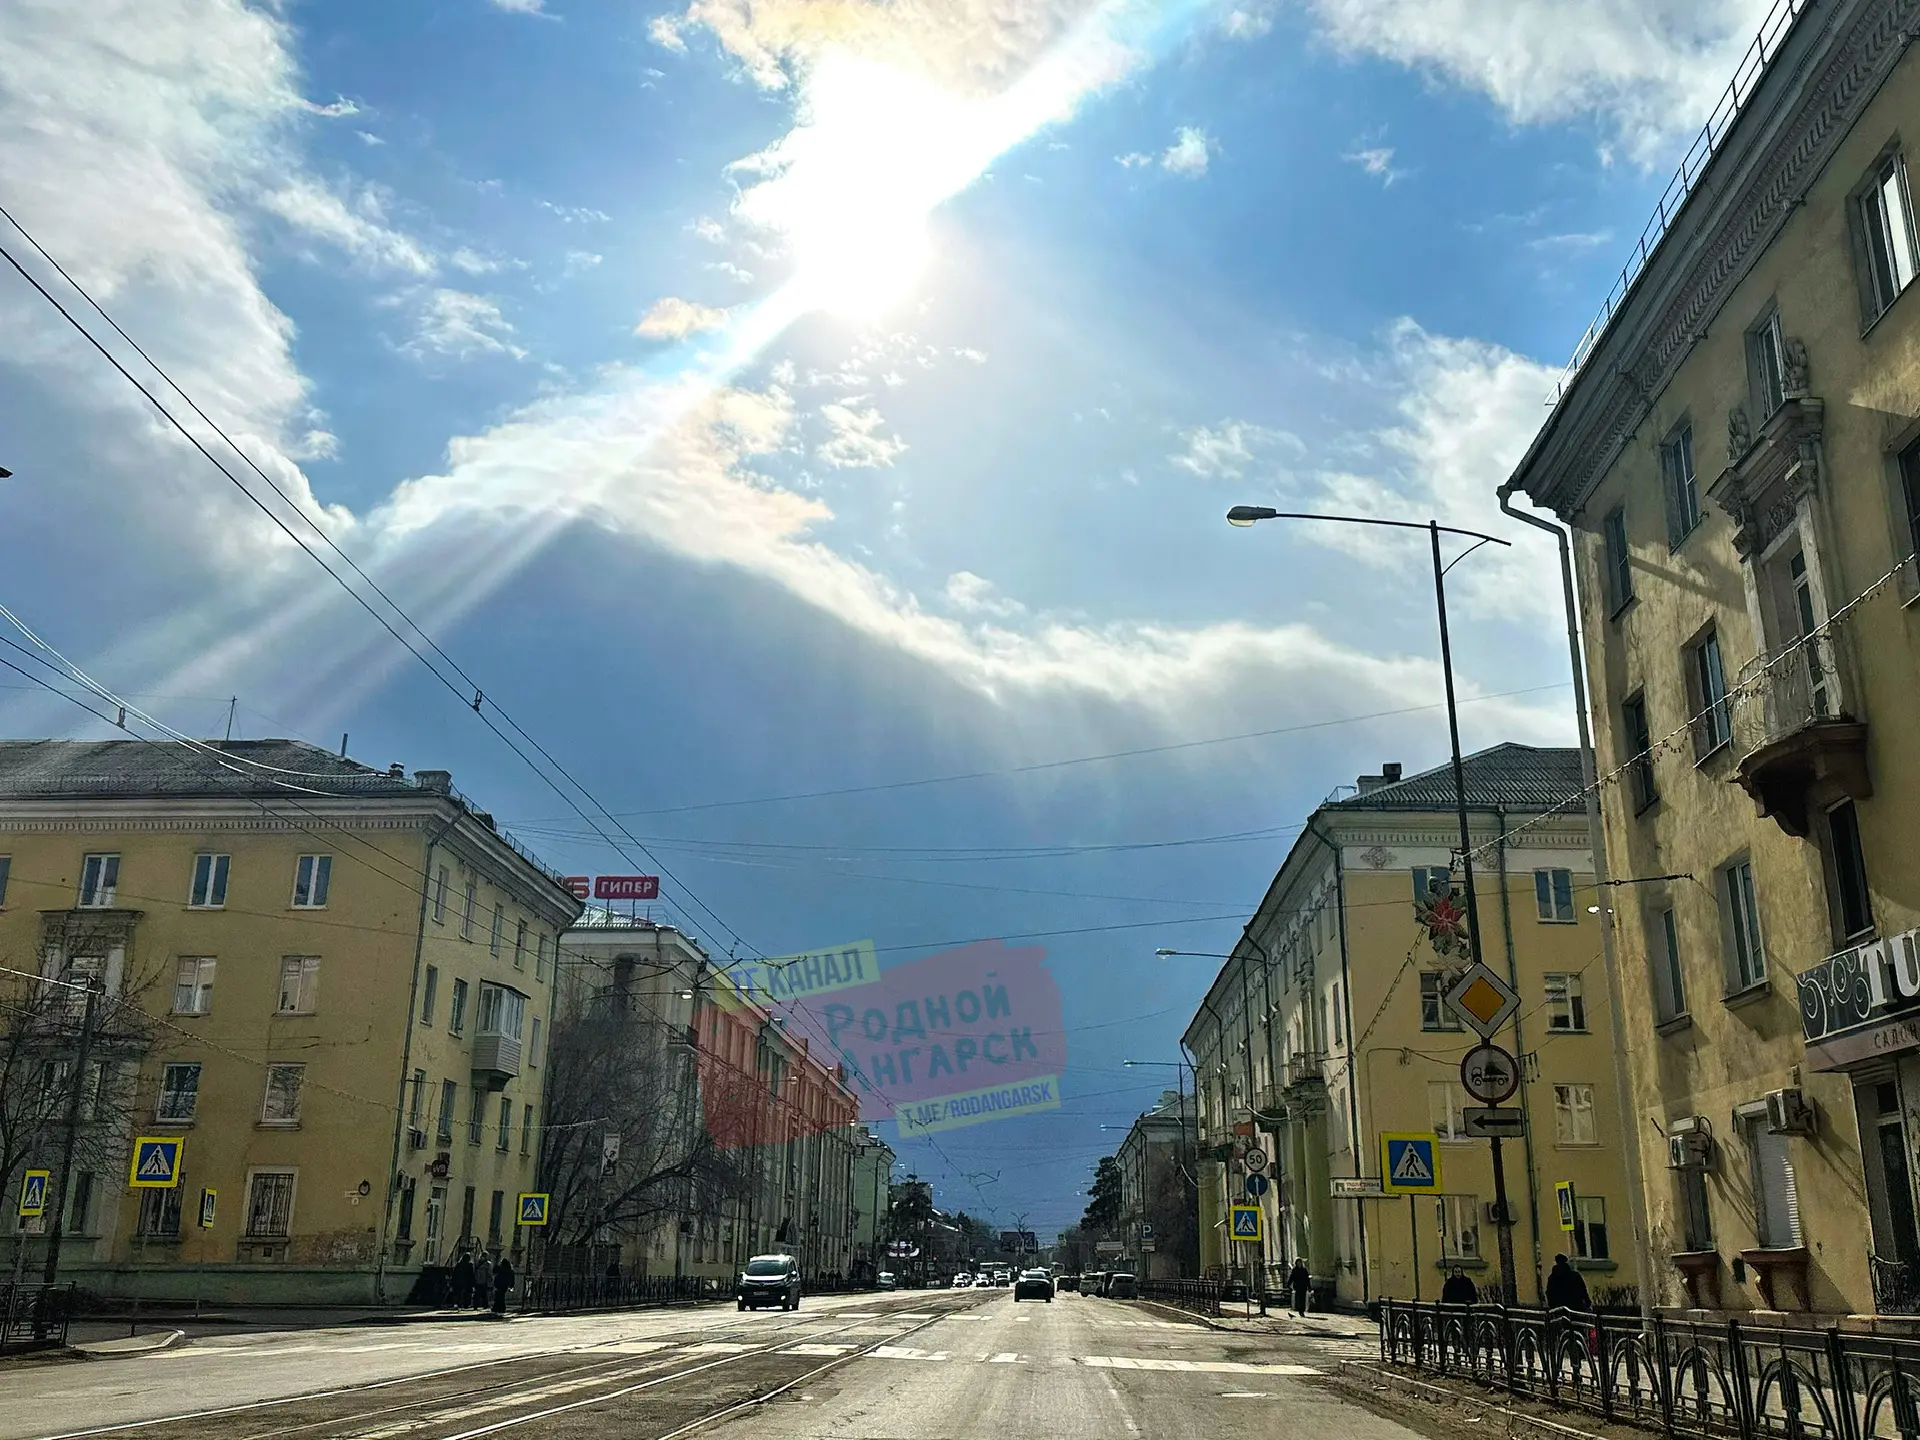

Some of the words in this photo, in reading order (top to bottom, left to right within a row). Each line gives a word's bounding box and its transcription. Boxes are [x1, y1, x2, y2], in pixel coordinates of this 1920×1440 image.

[601, 881, 652, 893] ГИПЕР
[1249, 1154, 1262, 1164] 50
[1142, 1224, 1152, 1238] P
